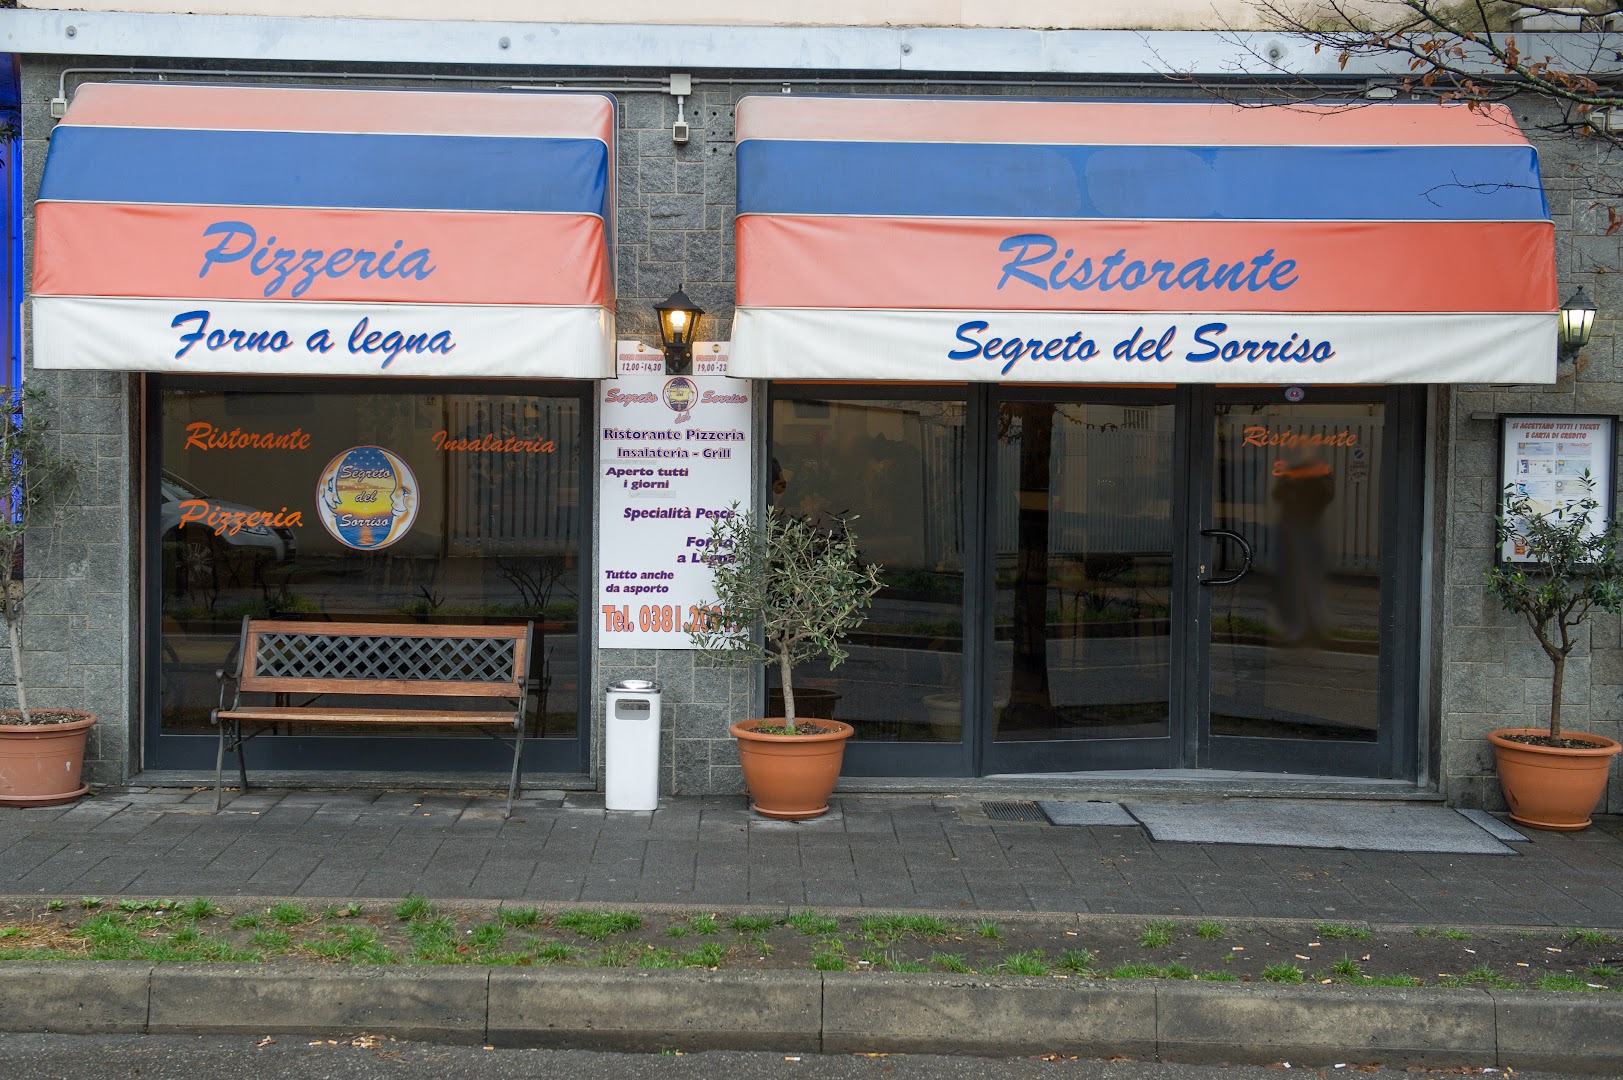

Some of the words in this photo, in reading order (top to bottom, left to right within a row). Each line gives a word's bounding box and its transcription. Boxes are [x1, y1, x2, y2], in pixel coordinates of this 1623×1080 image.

[199, 221, 437, 298] Pizzeria
[997, 233, 1299, 292] Ristorante
[170, 310, 293, 360] Forno
[305, 328, 334, 354] a
[347, 316, 457, 370] legna
[948, 320, 1100, 376] Segreto
[1113, 325, 1176, 363] del
[1185, 322, 1336, 364] Sorriso
[604, 388, 658, 407] Segreto
[701, 390, 748, 404] Sorriso
[675, 410, 691, 424] del
[1520, 422, 1555, 430] ACCETTANO
[185, 421, 311, 451] Ristorante
[431, 430, 556, 454] Insalateria
[603, 428, 682, 441] Ristorante
[686, 428, 746, 442] Pizzeria
[1242, 426, 1357, 448] Ristorante
[617, 447, 689, 459] Insalateria
[702, 447, 732, 459] Grill
[339, 464, 392, 483] Segreto
[605, 467, 654, 478] Aperto
[658, 467, 689, 477] tutti
[623, 479, 628, 488] i
[630, 479, 669, 490] giorni
[354, 489, 377, 503] del
[178, 500, 304, 536] Pizzeria
[339, 513, 390, 527] Sorriso
[623, 507, 692, 521] Specialità
[695, 507, 736, 519] Pesce
[686, 536, 734, 548] Foro
[677, 554, 687, 563] a
[605, 570, 637, 580] Tutto
[640, 570, 674, 580] anche
[605, 584, 620, 593] da
[623, 584, 669, 595] asporto
[602, 605, 635, 632] Tel.
